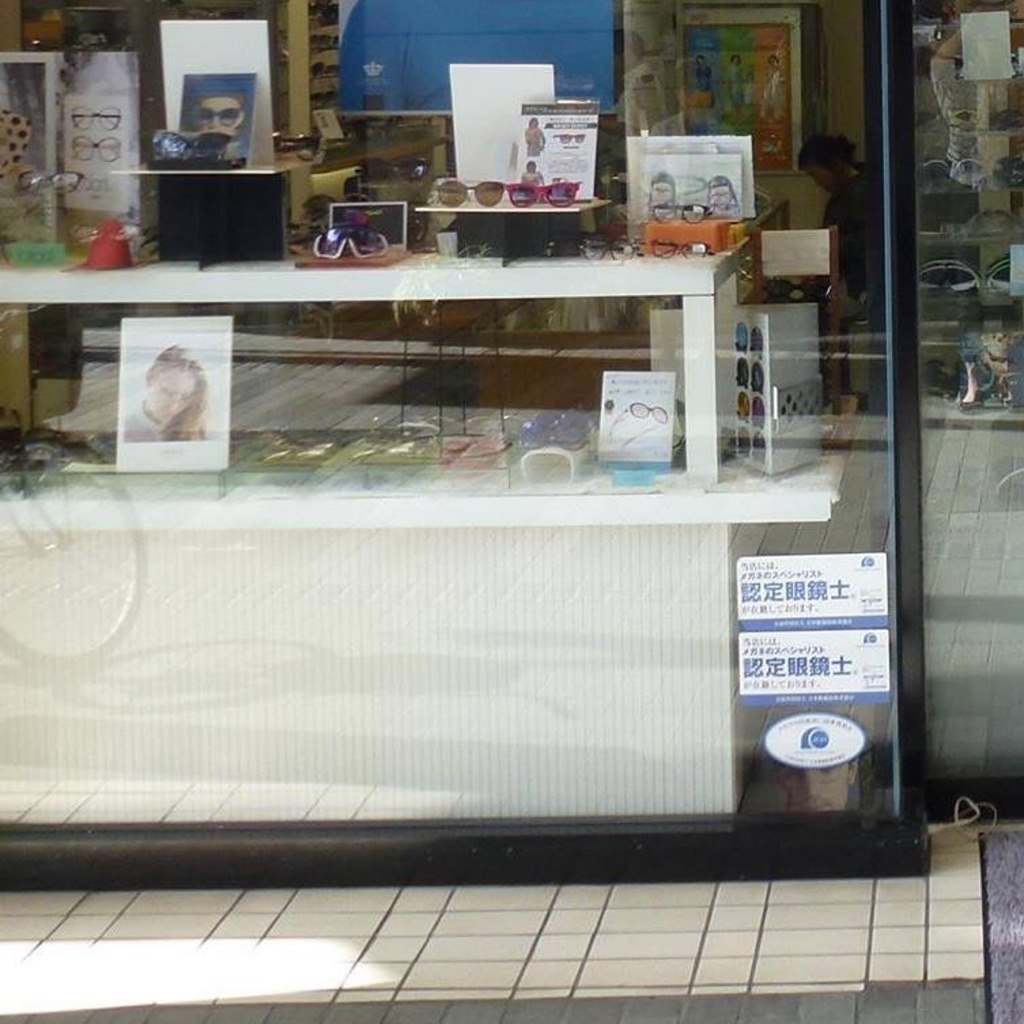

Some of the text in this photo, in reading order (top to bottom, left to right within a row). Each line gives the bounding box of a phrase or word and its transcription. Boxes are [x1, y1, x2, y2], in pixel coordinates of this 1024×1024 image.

[740, 570, 824, 581] メガネのスペシャリスト
[740, 579, 851, 603] 認定眼鏡士
[742, 645, 826, 656] メガネのスペシャリスト
[743, 655, 853, 679] 認定眼鏡士
